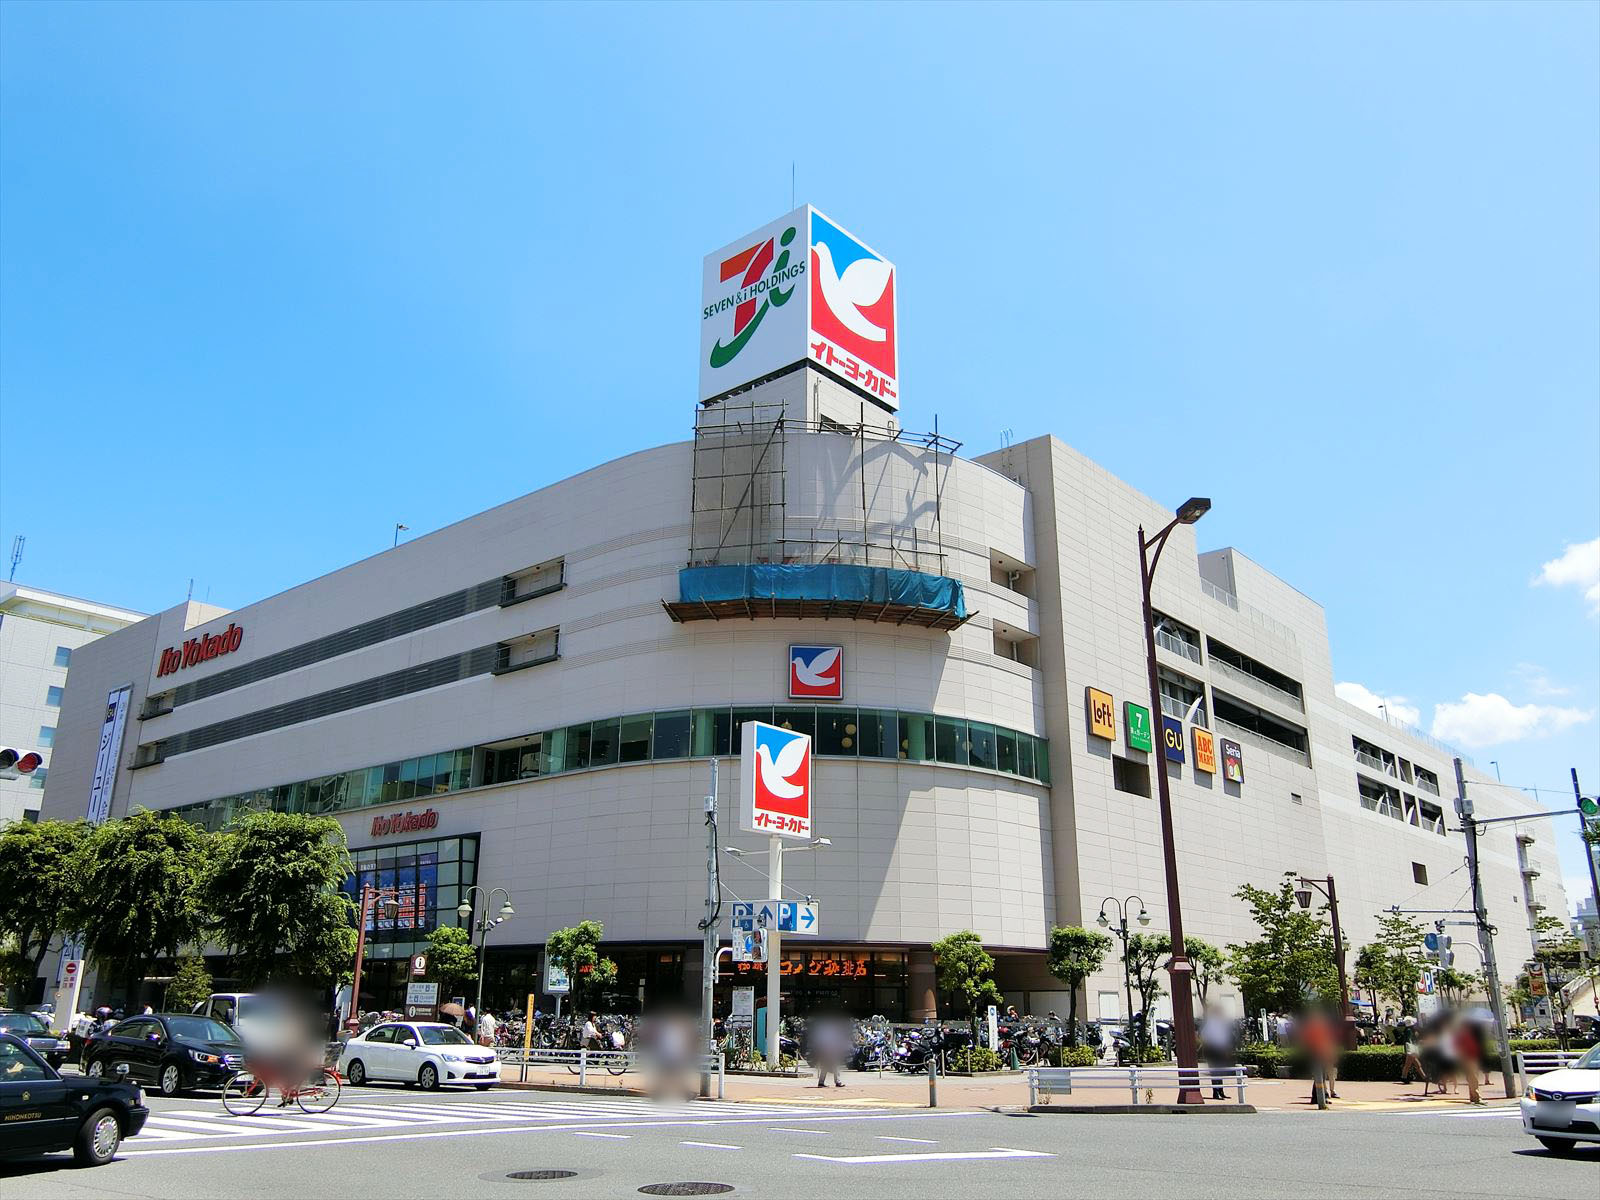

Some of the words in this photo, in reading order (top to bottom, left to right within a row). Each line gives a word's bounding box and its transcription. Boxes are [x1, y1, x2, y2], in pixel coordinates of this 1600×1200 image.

[703, 295, 735, 320] SEVEN
[749, 261, 806, 298] HOLDINGS
[810, 341, 897, 399] イトーヨーカドー
[156, 646, 182, 678] Ito
[180, 622, 244, 670] Yokado
[1165, 728, 1183, 751] GU
[1197, 735, 1213, 753] ABC
[1225, 743, 1241, 759] Seria
[1198, 753, 1214, 768] MART
[754, 812, 809, 834] イトーヨーカドー
[779, 903, 792, 926] P
